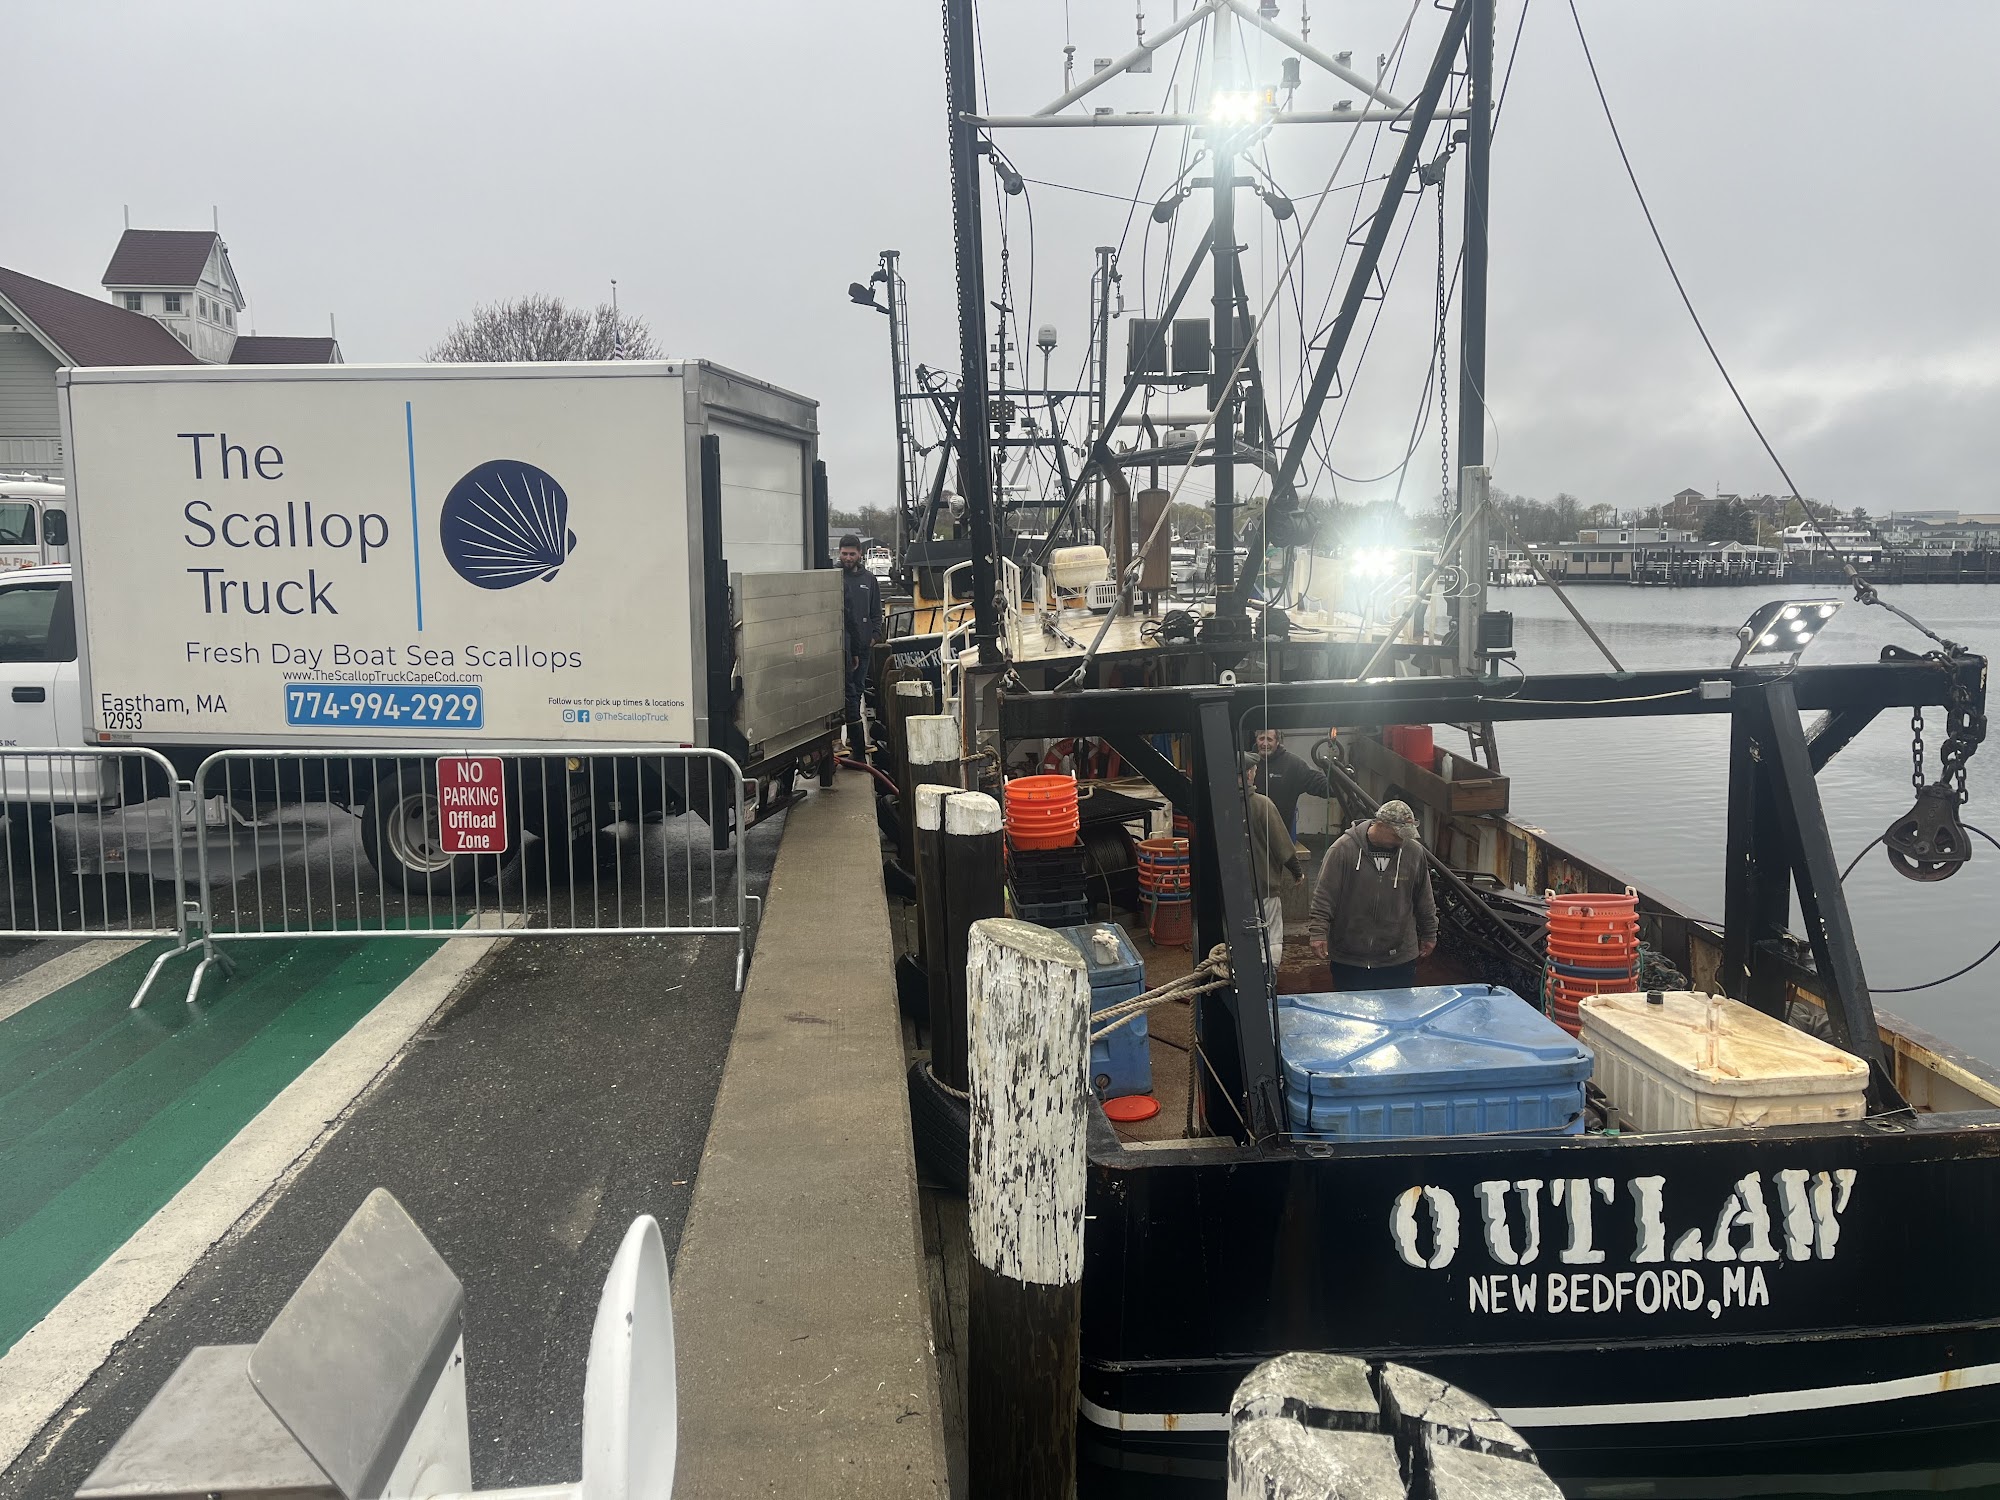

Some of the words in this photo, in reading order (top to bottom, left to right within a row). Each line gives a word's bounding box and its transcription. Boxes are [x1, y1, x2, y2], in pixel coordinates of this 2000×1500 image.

[177, 433, 284, 480] The
[184, 500, 389, 563] Scallop
[187, 568, 339, 615] Truck
[186, 641, 260, 664] Fresh
[271, 643, 323, 670] Day
[333, 644, 397, 666] Boat
[406, 645, 455, 667] Sea
[465, 645, 582, 673] Scallops
[282, 670, 483, 685] www.TheScallopTruckCapeCod.com
[101, 693, 190, 715] Eastham,
[196, 694, 228, 713] MA
[289, 691, 478, 722] 774-994-2929
[548, 697, 572, 705] Follow
[583, 698, 594, 706] for
[595, 699, 610, 707] pick
[611, 700, 622, 708] up
[644, 699, 650, 707] &
[652, 699, 685, 707] locations
[102, 712, 143, 730] 12953
[594, 712, 669, 723] @TheScallopTruck
[457, 761, 483, 783] NO
[443, 786, 499, 806] PARKING
[448, 810, 497, 829] Offload
[457, 830, 490, 849] Zone
[1389, 1168, 1858, 1270] OUTLAW
[1468, 1273, 1538, 1314] NEW
